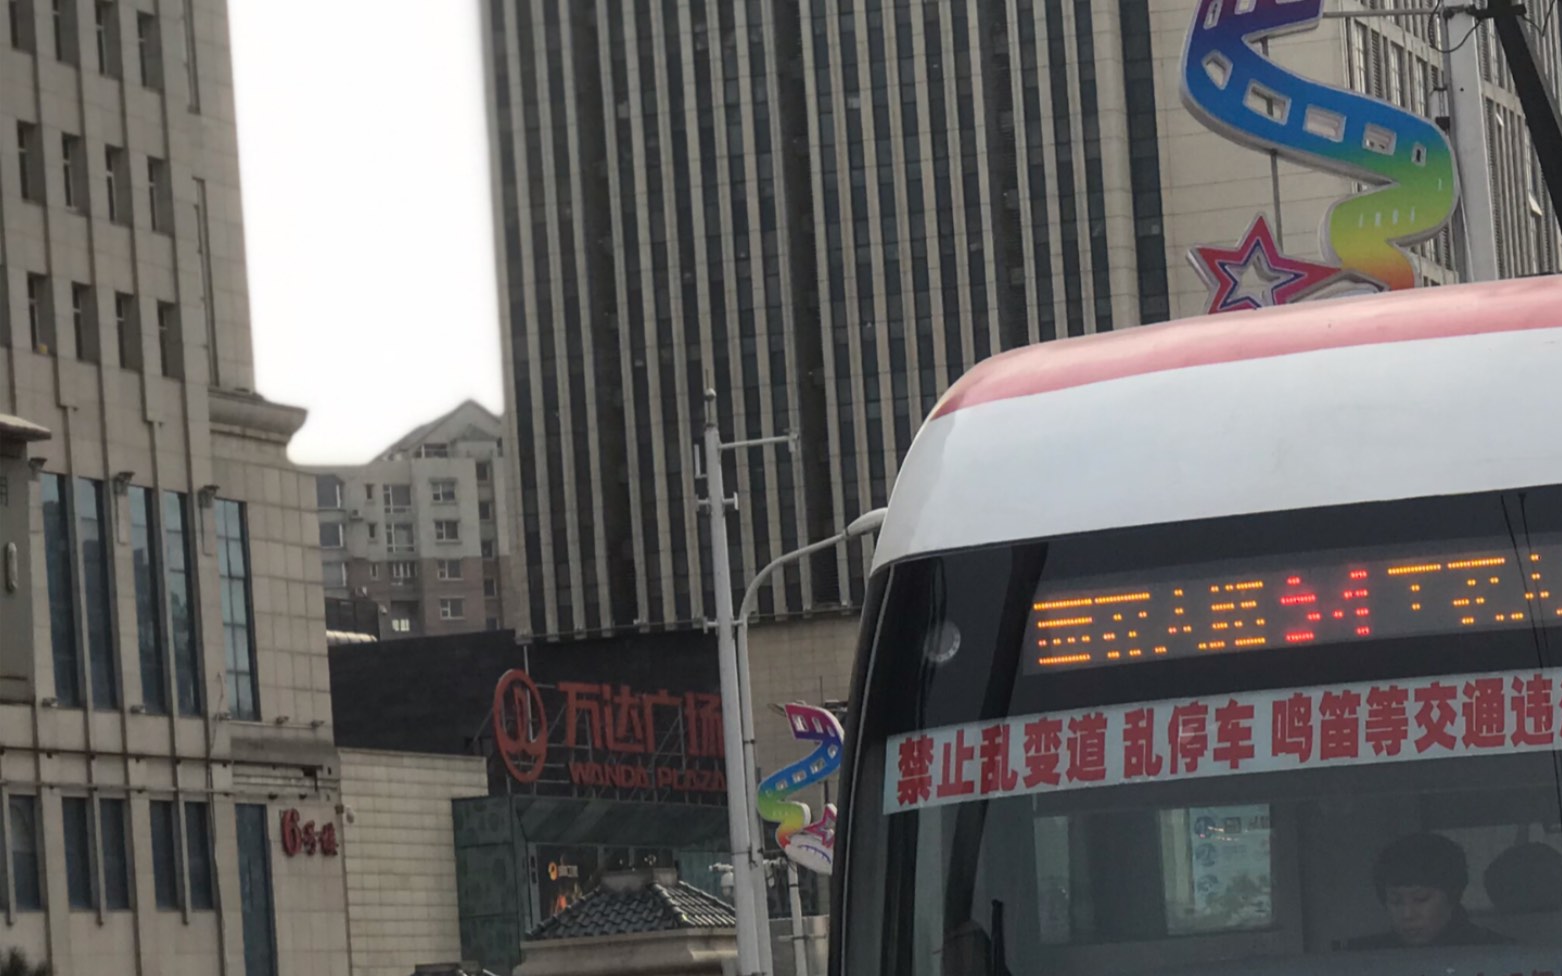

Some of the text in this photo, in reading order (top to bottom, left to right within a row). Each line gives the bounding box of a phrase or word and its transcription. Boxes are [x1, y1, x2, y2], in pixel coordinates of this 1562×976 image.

[556, 682, 726, 758] 万达广场
[896, 711, 1108, 806] 禁止乱变道
[1123, 699, 1255, 779] 乱停车
[569, 761, 727, 793] WANDA PLAZA
